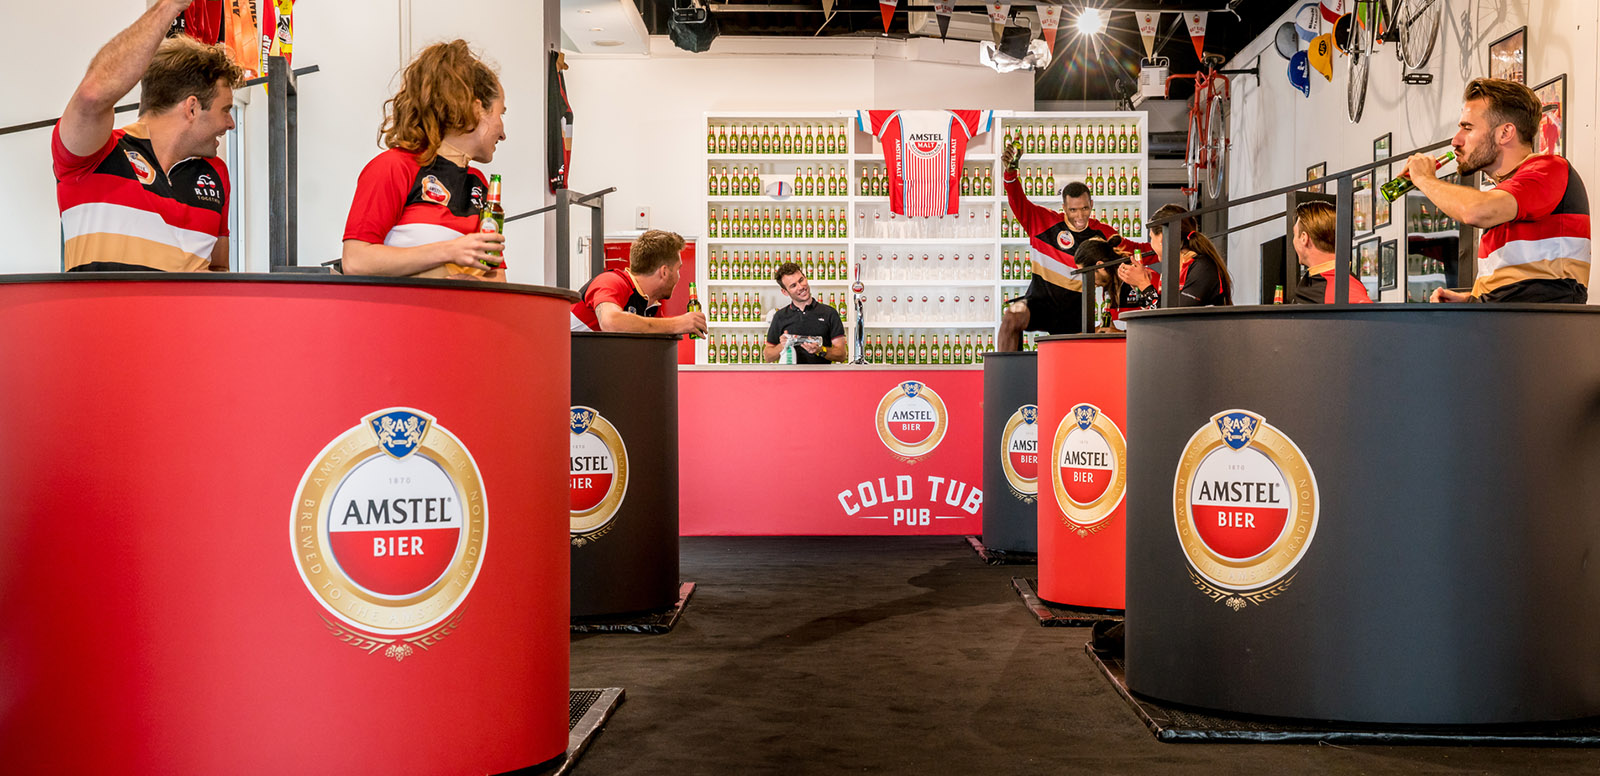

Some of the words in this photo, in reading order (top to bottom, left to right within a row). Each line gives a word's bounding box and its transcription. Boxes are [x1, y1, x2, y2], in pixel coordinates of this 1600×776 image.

[892, 410, 932, 421] AMSTEL
[902, 423, 921, 431] BIER
[1012, 440, 1038, 451] AMST
[314, 436, 367, 488] AMSTEL
[570, 456, 608, 472] STEL
[1020, 455, 1038, 464] BIER
[1064, 450, 1108, 467] AMSTEL
[388, 476, 411, 485] 1870
[1073, 471, 1094, 483] BIER
[837, 475, 913, 516] COLD
[928, 475, 983, 515] TUB
[1198, 480, 1280, 504] AMSTEL
[341, 496, 453, 526] AMSTEL
[893, 508, 930, 526] PUB
[1217, 511, 1256, 528] BIER
[1282, 477, 1311, 559] TRADITION
[373, 536, 425, 557] BIER
[298, 497, 323, 576] BREWED
[322, 579, 343, 602] TO
[347, 601, 379, 624] THE
[454, 489, 482, 591] TRADITION
